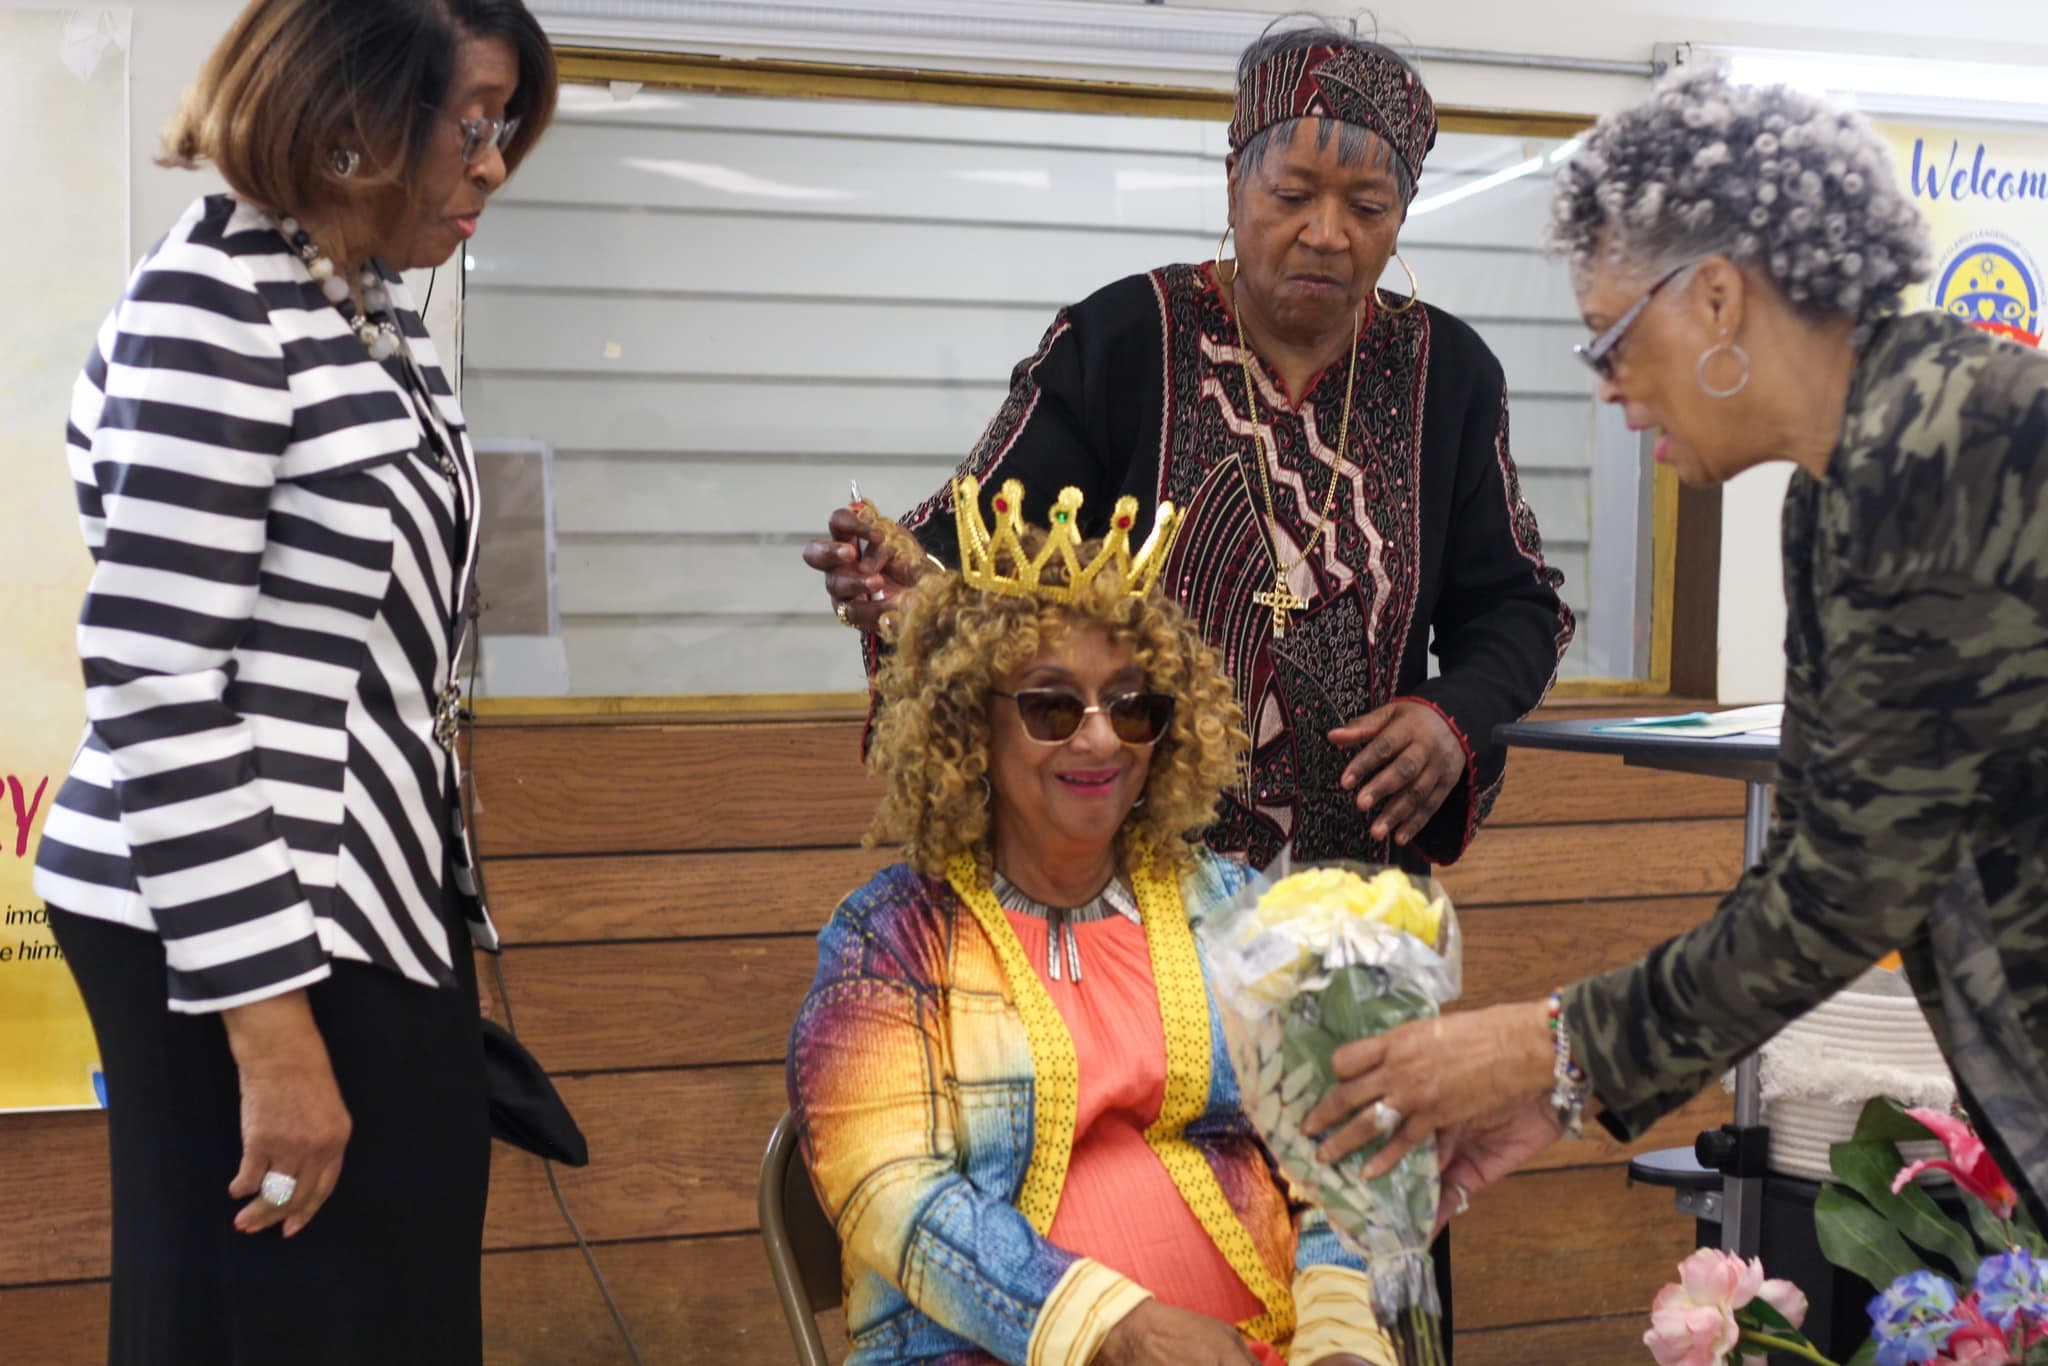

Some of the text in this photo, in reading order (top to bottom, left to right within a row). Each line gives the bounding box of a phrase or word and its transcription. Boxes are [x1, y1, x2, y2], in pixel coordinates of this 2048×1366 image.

[1912, 138, 2047, 201] Welcom
[0, 774, 48, 858] Y
[5, 904, 52, 928] ima
